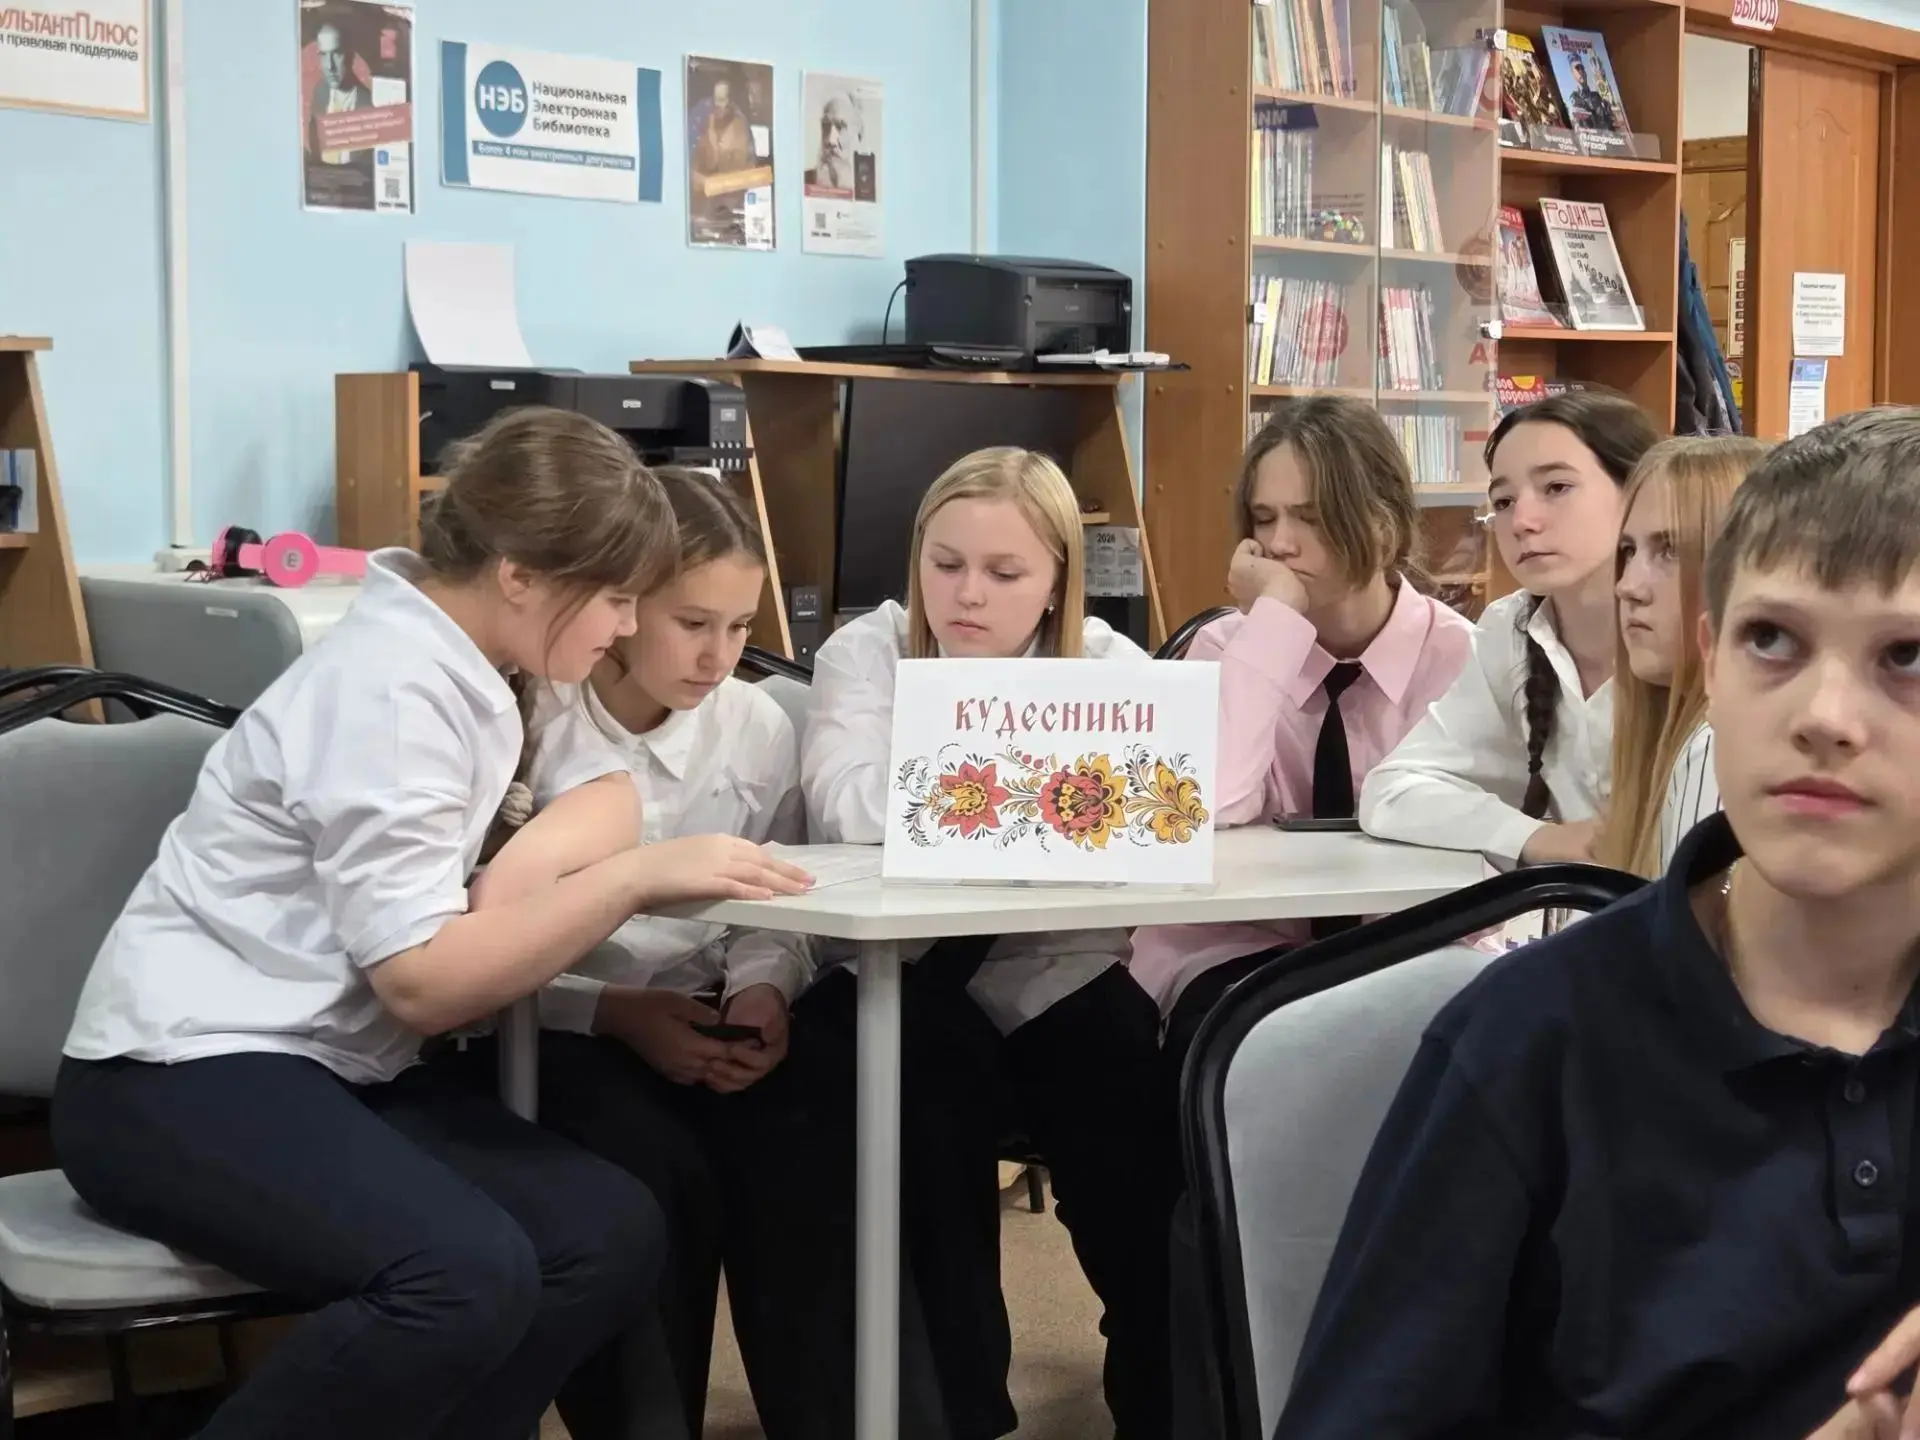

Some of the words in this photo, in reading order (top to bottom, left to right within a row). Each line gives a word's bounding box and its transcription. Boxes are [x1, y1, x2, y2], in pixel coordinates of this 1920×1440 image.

[1734, 0, 1777, 25] ВЫХОД
[7, 33, 67, 52] правовая
[70, 42, 138, 61] поддержка
[480, 84, 525, 113] НЭБ
[532, 80, 627, 106] Национальная
[532, 99, 617, 121] Электронная
[532, 117, 611, 138] Библиотека
